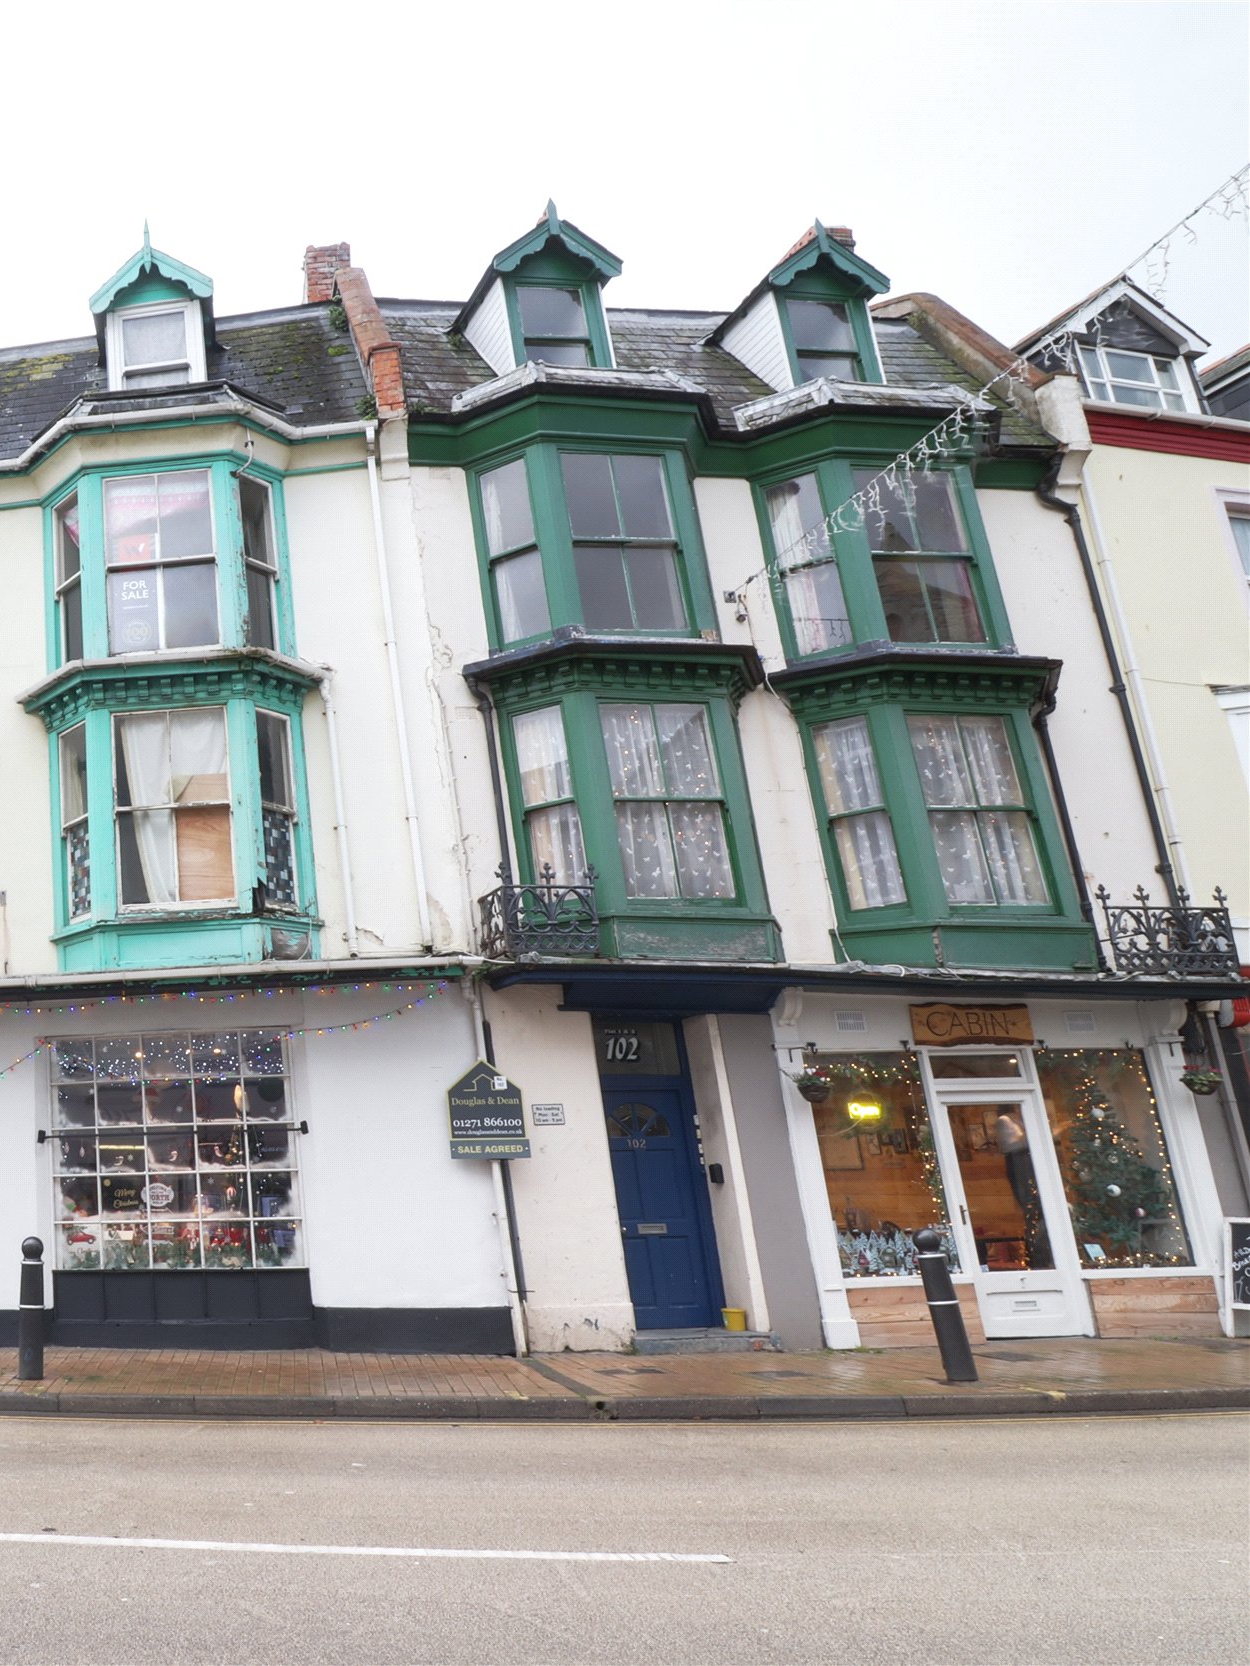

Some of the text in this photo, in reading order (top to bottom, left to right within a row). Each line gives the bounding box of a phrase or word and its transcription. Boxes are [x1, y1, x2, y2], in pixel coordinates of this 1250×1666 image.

[123, 580, 147, 590] FOR
[121, 590, 149, 600] SALE
[925, 1011, 1011, 1037] CABIN
[606, 1036, 638, 1060] 102
[451, 1096, 520, 1107] Douglas & Dean
[849, 1103, 880, 1119] Open
[453, 1117, 523, 1128] 01271 866100
[457, 1144, 524, 1154] SALE AGREED
[627, 1138, 646, 1149] 102
